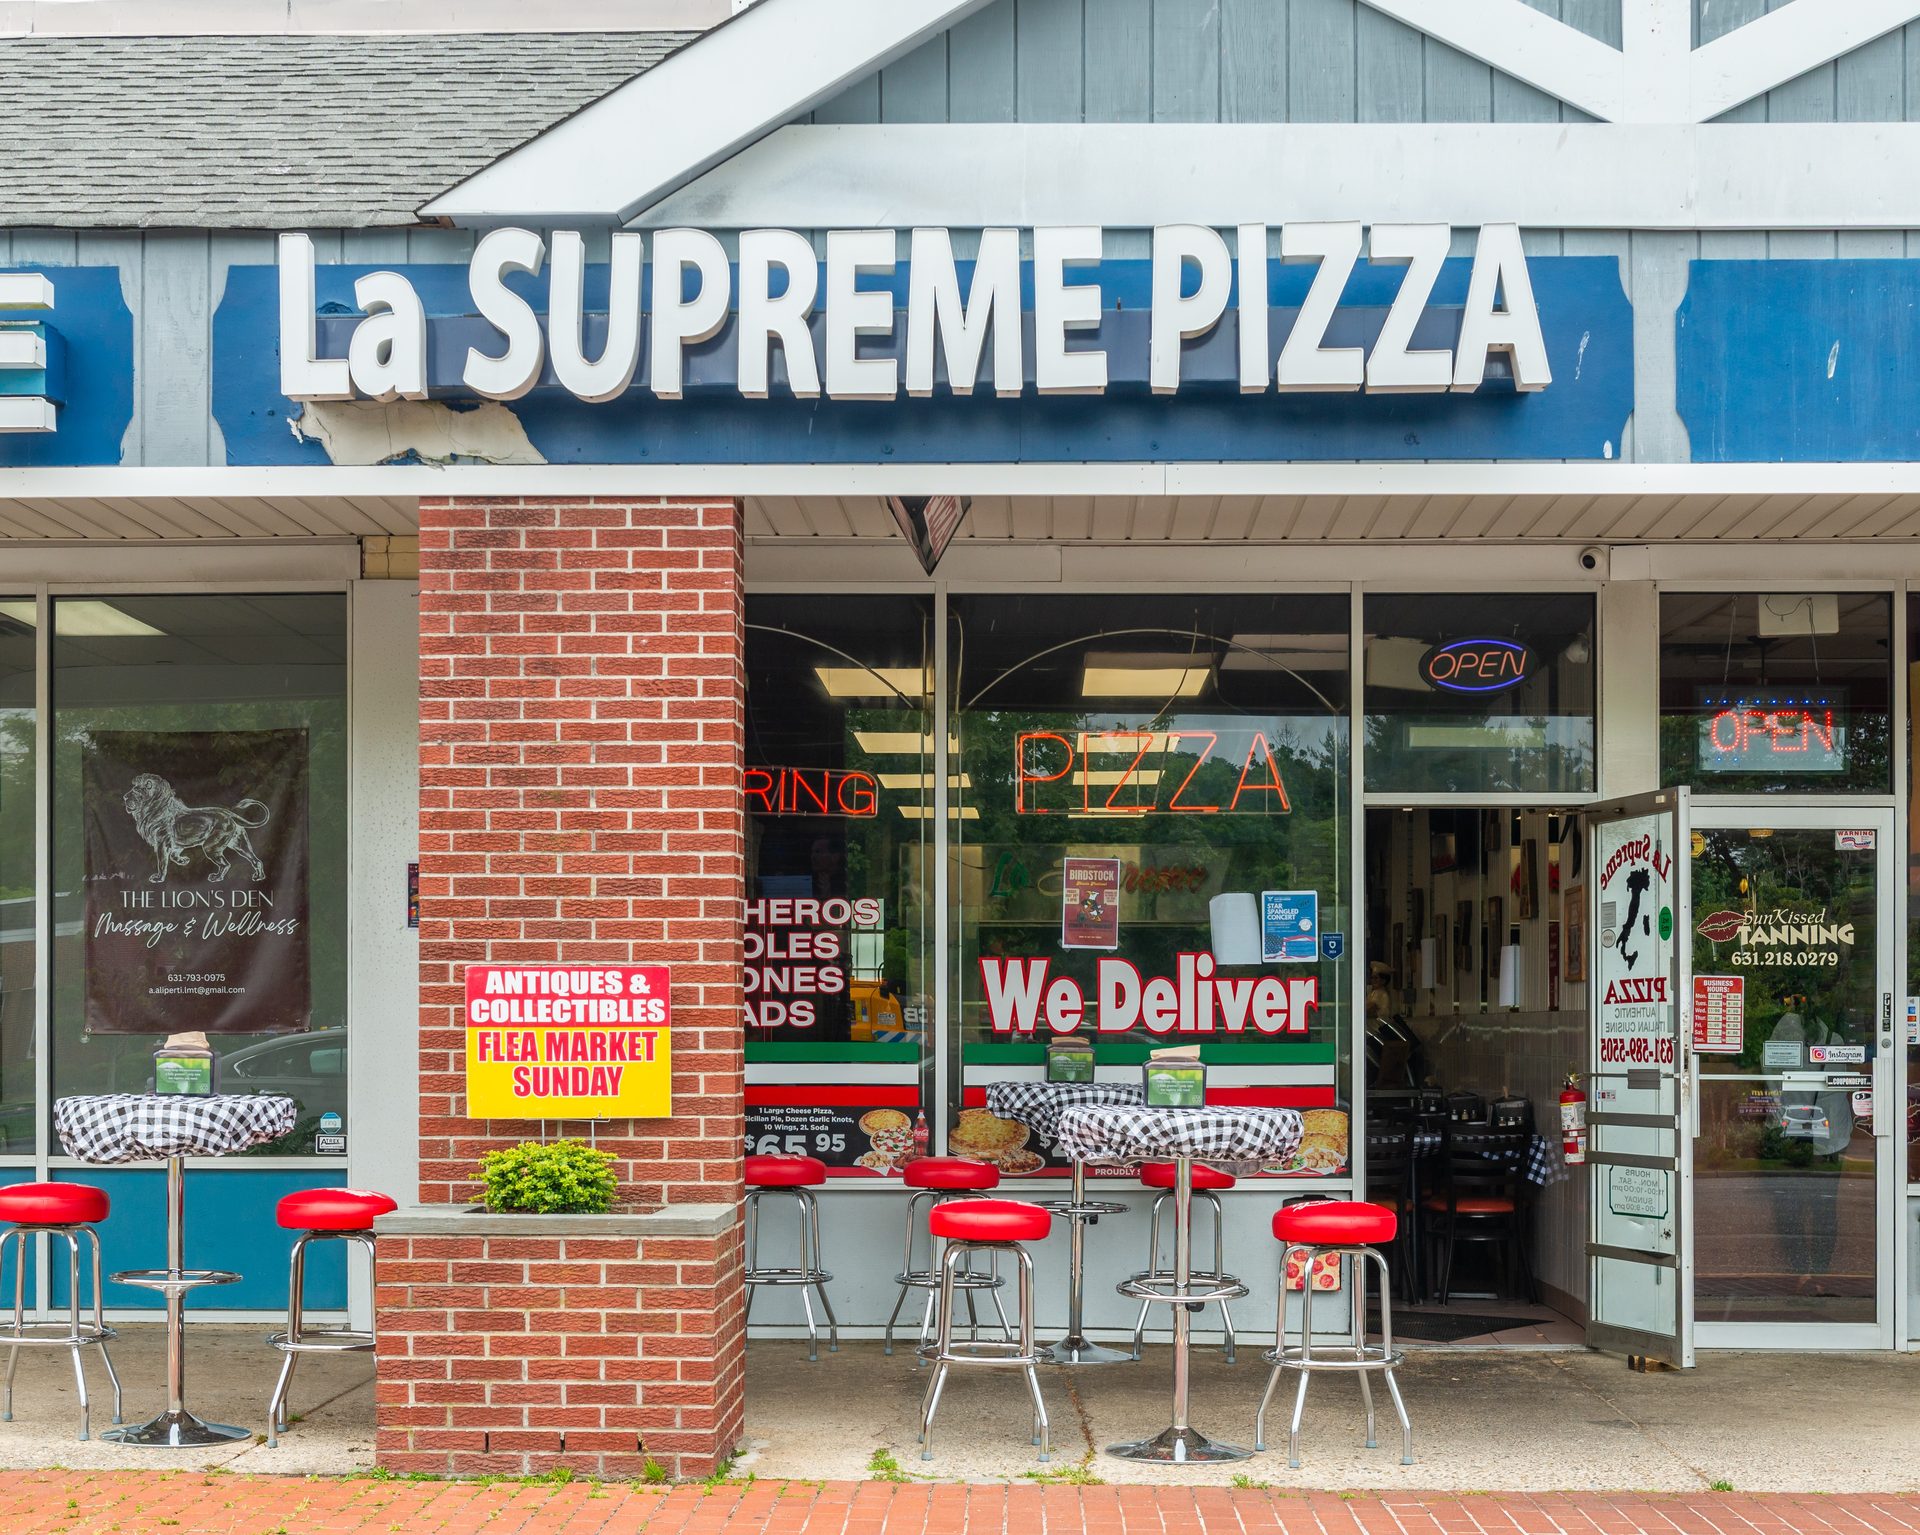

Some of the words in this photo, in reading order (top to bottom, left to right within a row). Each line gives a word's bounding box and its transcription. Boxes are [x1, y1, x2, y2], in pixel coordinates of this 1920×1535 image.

[279, 232, 428, 402] La
[463, 226, 1108, 403] SUPREME
[1150, 220, 1552, 394] PIZZA
[1428, 650, 1527, 681] OPEN
[1710, 710, 1833, 752] OPEN
[1018, 731, 1291, 813] PIZZA
[743, 769, 876, 815] RING
[1069, 869, 1115, 881] BIRDSTOCK
[119, 890, 155, 909] THE
[161, 890, 226, 909] LION'S
[231, 890, 274, 909] DEN
[744, 898, 881, 925] HEROS
[94, 911, 179, 949] Massage
[183, 916, 198, 938] &
[201, 911, 300, 940] Wellness
[1743, 908, 1827, 925] SunKissed
[744, 932, 841, 960] OLES
[1737, 923, 1855, 946] TANNING
[1731, 951, 1839, 966] 631.218.0279
[148, 986, 246, 996] a.aliperti.lmt@gmail.com
[167, 973, 226, 982] 631-793-0975
[485, 970, 623, 997] ANTIQUES
[629, 973, 651, 995] &
[744, 966, 846, 994] ONES
[978, 957, 1084, 1034] We
[1097, 952, 1319, 1034] Deliver
[469, 998, 666, 1024] COLLECTIBLES
[744, 1000, 817, 1028] ADS
[478, 1031, 540, 1062] FLEA
[545, 1031, 659, 1062] MARKET
[1827, 1050, 1863, 1060] Instagram
[512, 1065, 624, 1097] SUNDAY
[831, 1116, 855, 1124] Knots,
[815, 1133, 846, 1152] 95
[1094, 1168, 1135, 1176] PROUDLY
